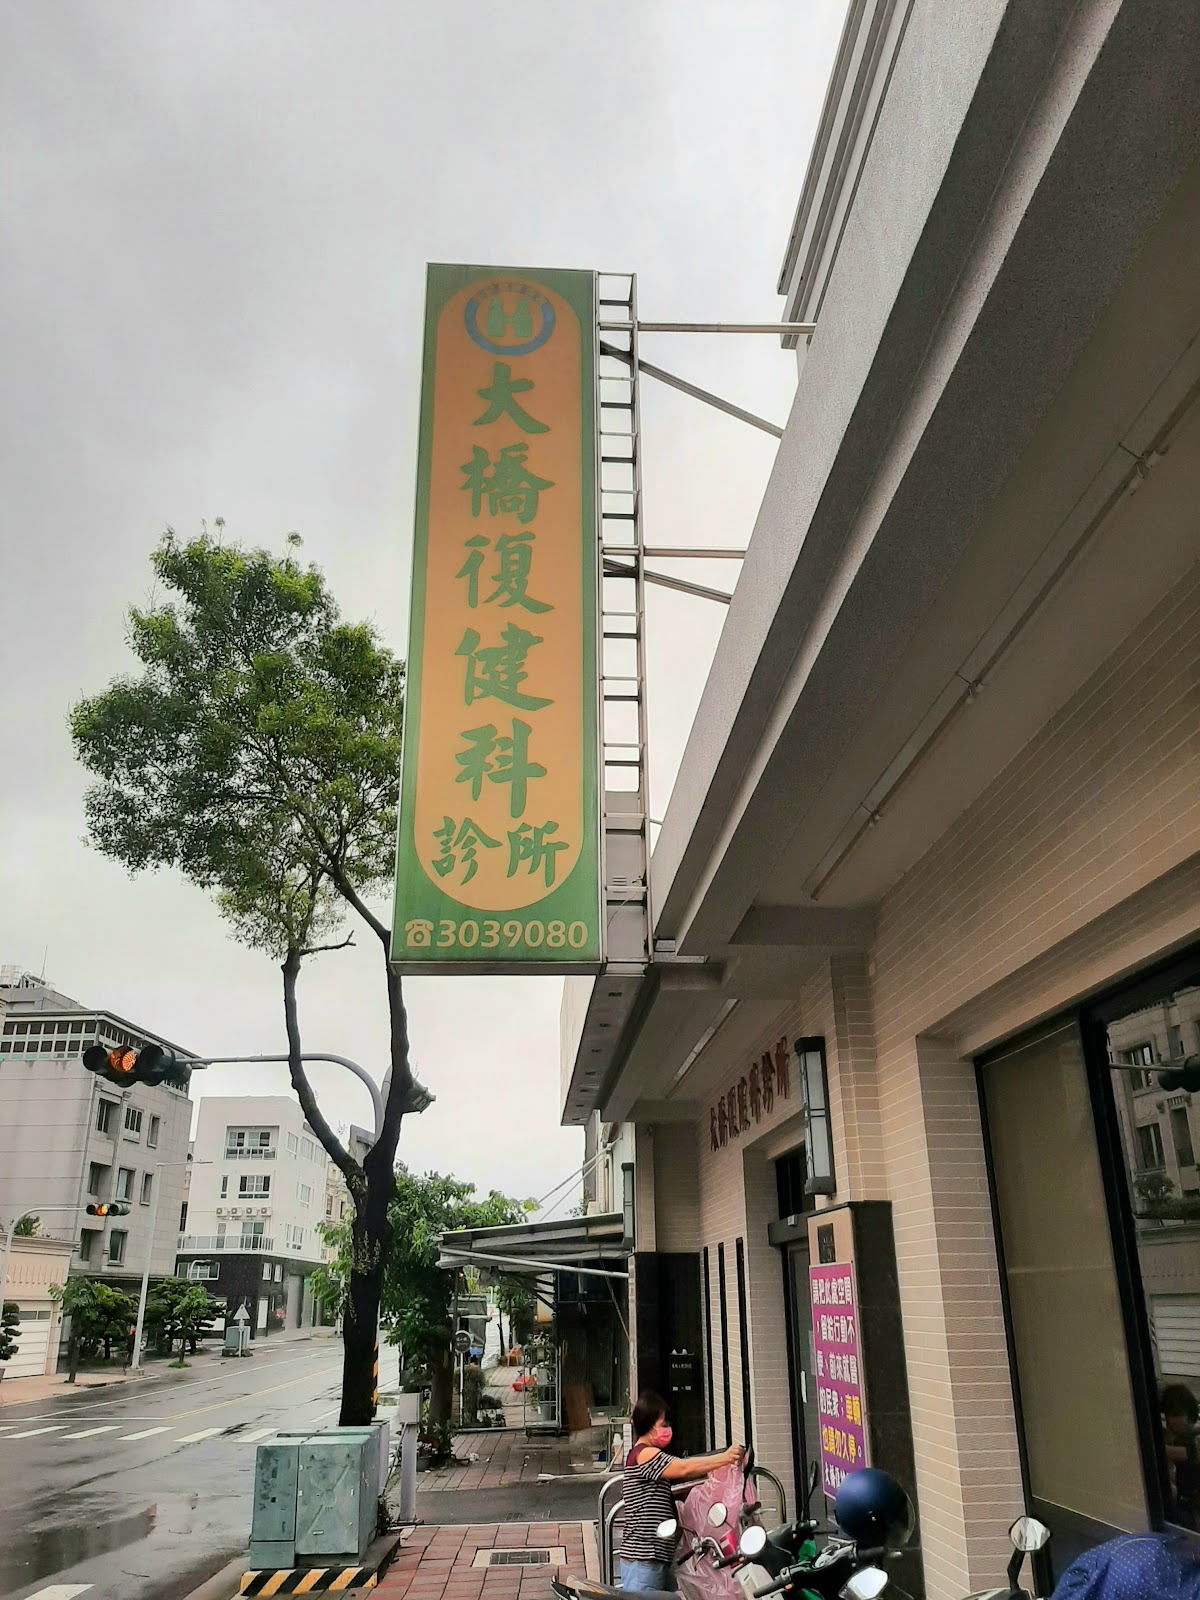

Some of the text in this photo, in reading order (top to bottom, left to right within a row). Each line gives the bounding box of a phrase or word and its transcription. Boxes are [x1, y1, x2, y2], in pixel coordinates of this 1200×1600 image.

[455, 360, 556, 819] 大橋復健科
[432, 816, 570, 888] 診所
[436, 919, 589, 948] 3039080
